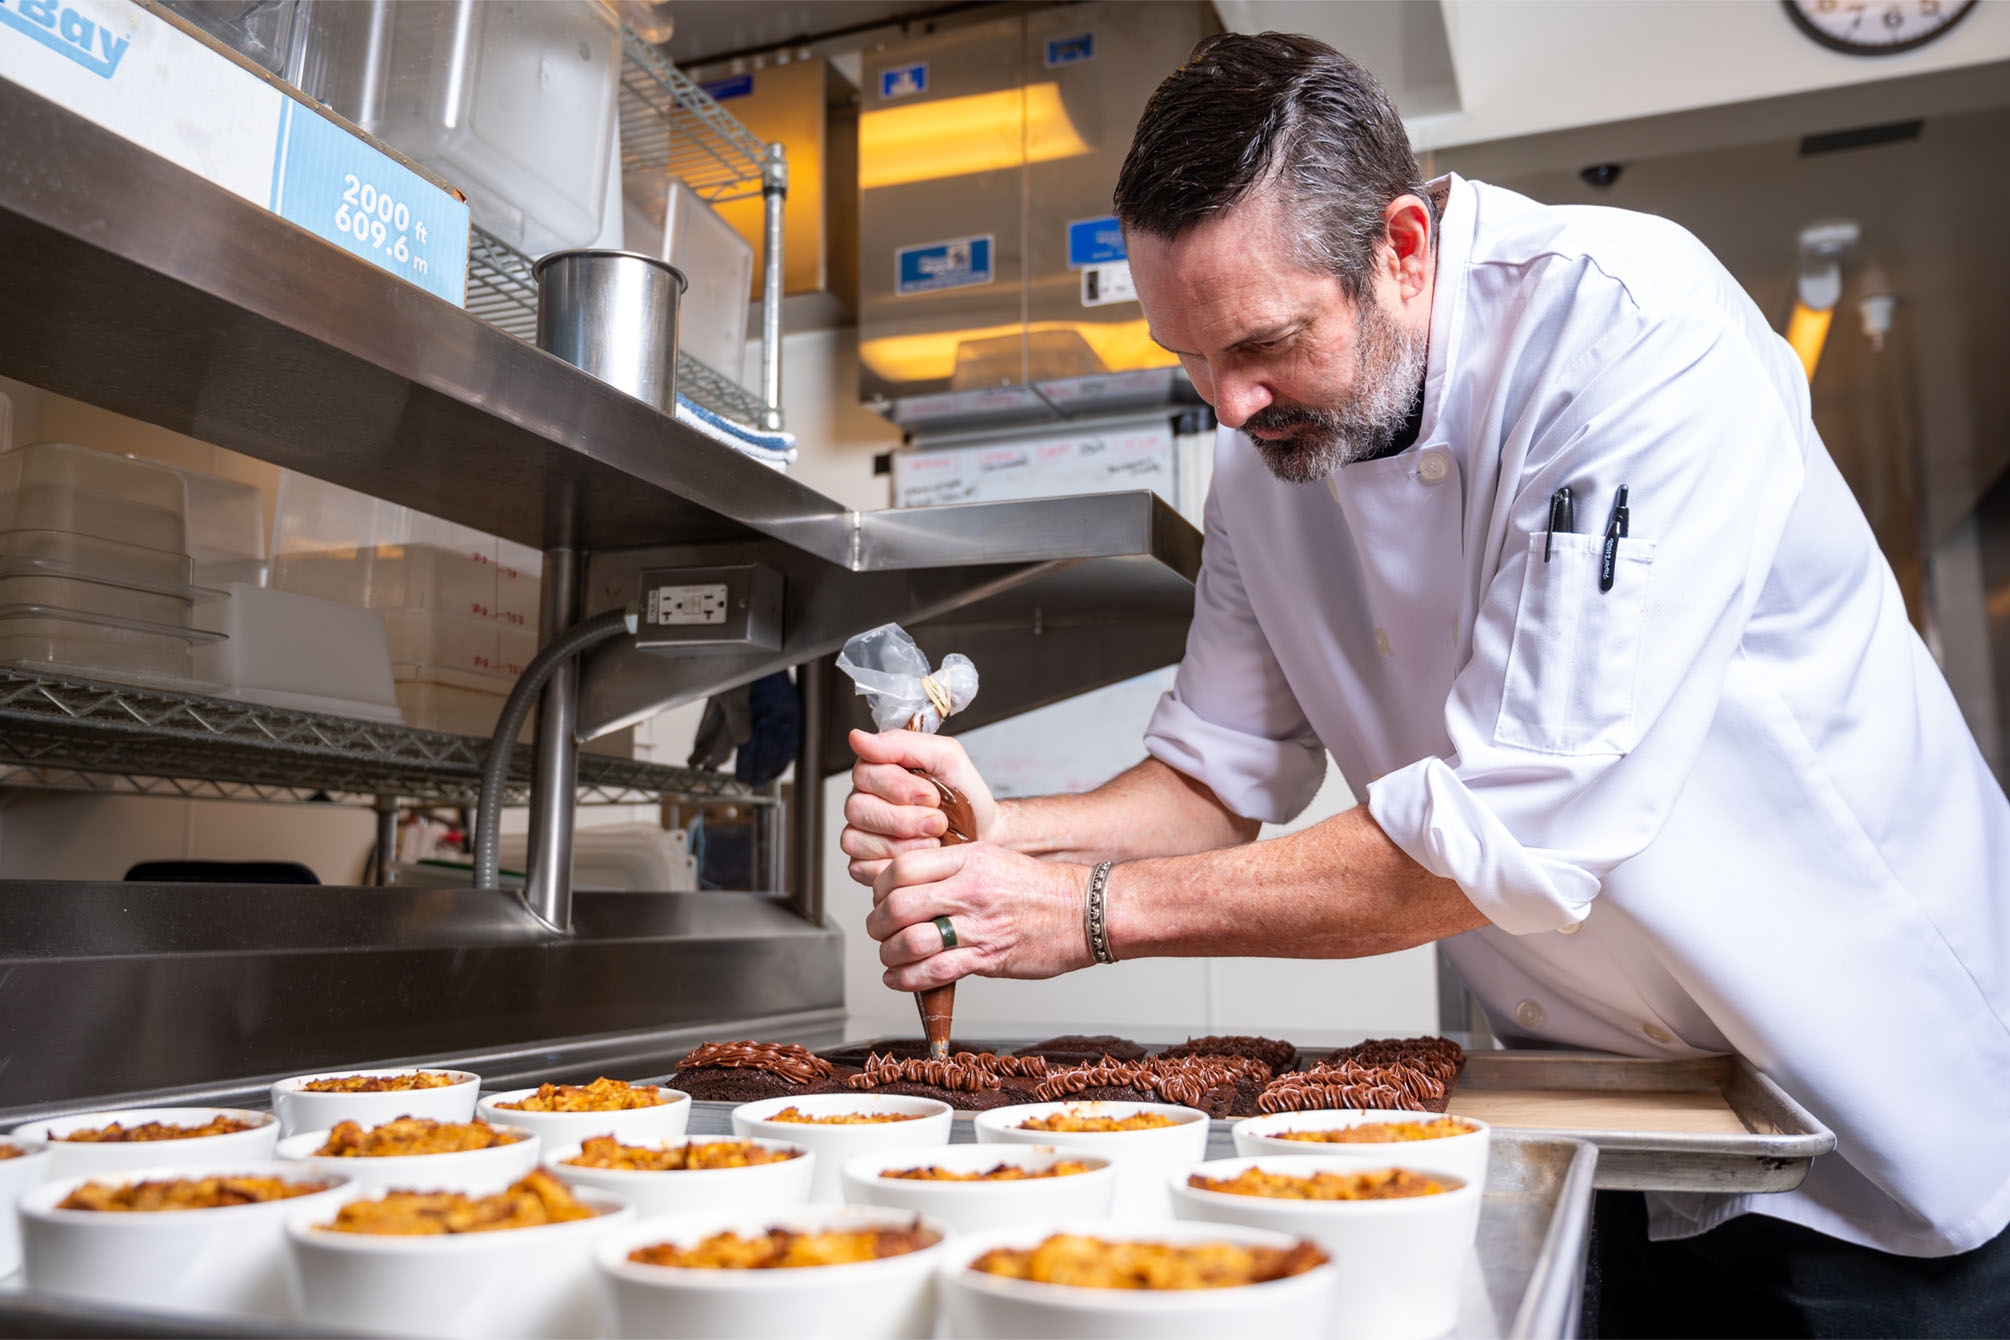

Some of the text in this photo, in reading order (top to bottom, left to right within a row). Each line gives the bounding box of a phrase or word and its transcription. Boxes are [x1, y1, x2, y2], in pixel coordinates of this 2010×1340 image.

[1882, 3, 1905, 30] 6
[335, 202, 428, 275] 609.6 m
[342, 173, 427, 244] 2000 ft
